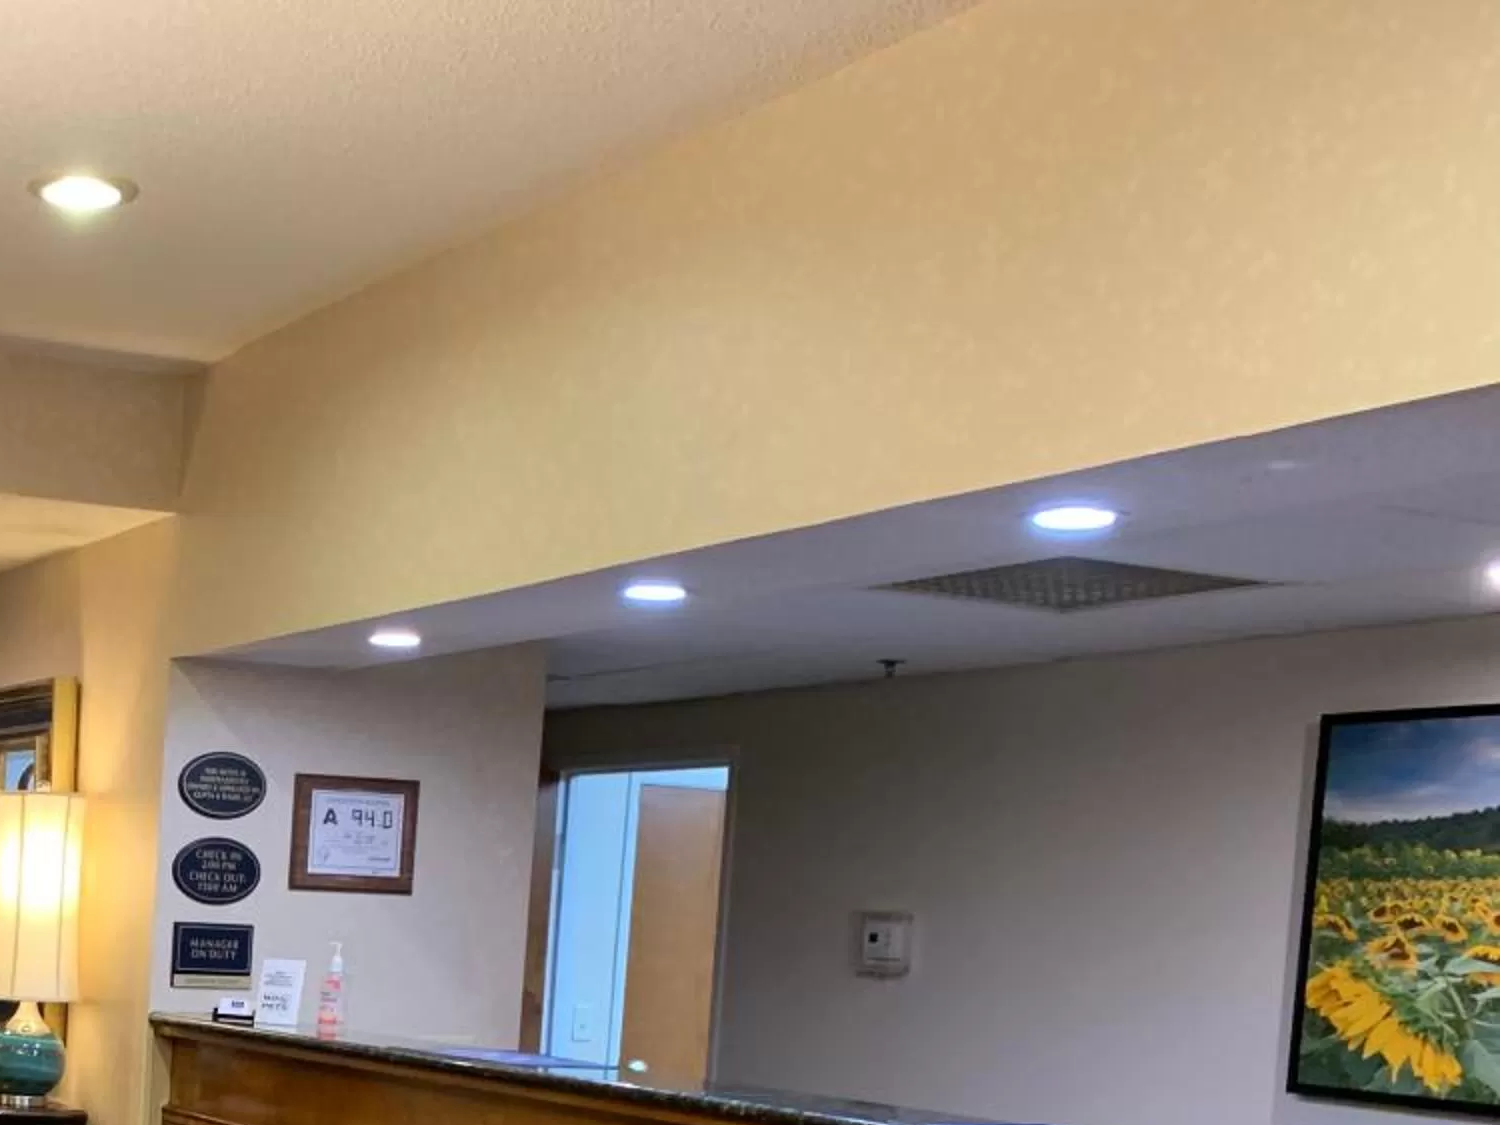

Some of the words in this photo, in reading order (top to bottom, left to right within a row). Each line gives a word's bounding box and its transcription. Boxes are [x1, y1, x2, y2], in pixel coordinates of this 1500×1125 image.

[323, 807, 338, 825] A
[195, 849, 227, 860] CHECK
[189, 871, 221, 882] CHECK
[221, 883, 237, 893] AM
[189, 936, 240, 949] MANAGER
[191, 949, 208, 960] ON
[209, 950, 237, 961] DUTY
